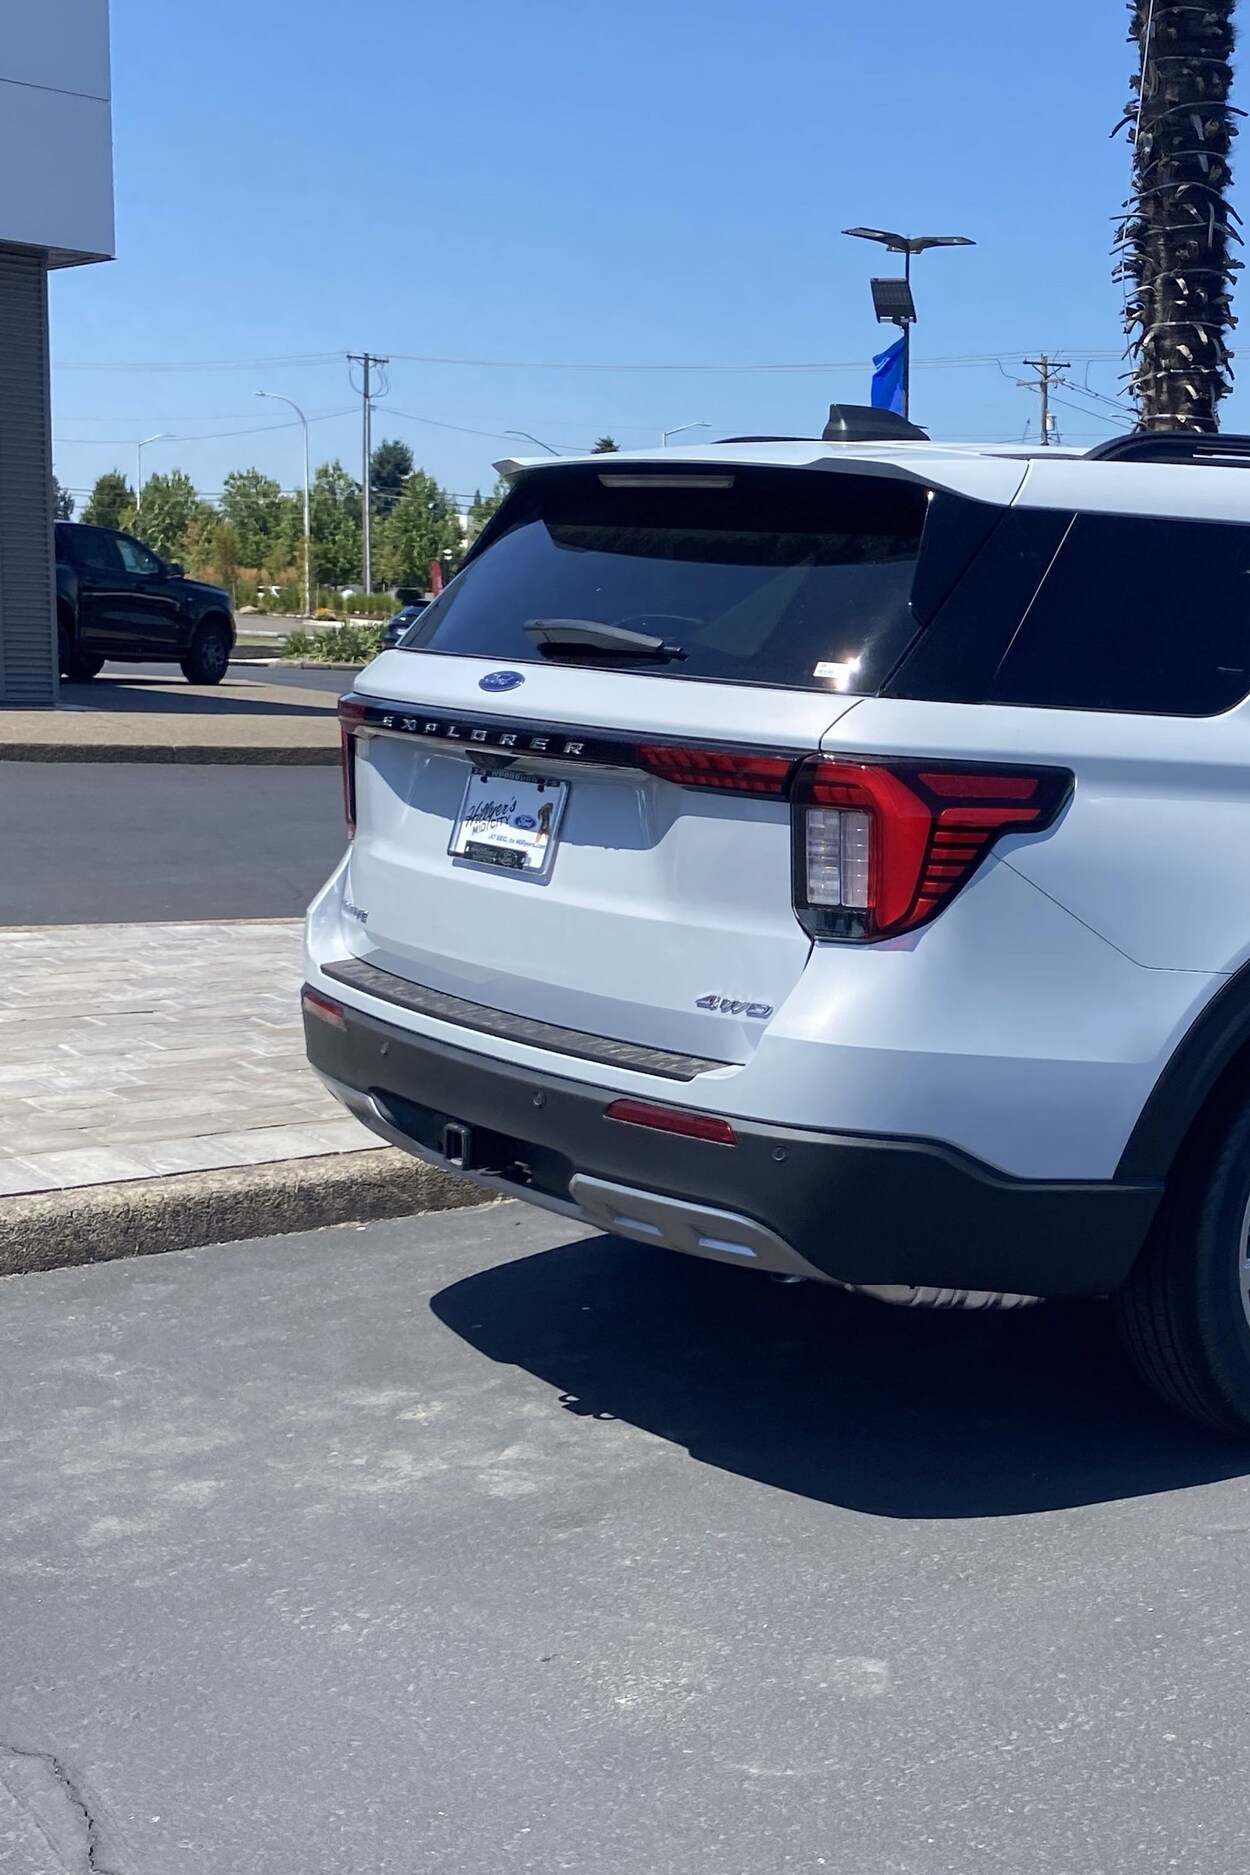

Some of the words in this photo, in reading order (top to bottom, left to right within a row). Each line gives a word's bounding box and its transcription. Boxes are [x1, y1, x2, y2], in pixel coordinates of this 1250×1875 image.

[382, 716, 585, 755] EXPLORER
[465, 796, 517, 827] Hillyer's
[695, 995, 774, 1019] 4WD
